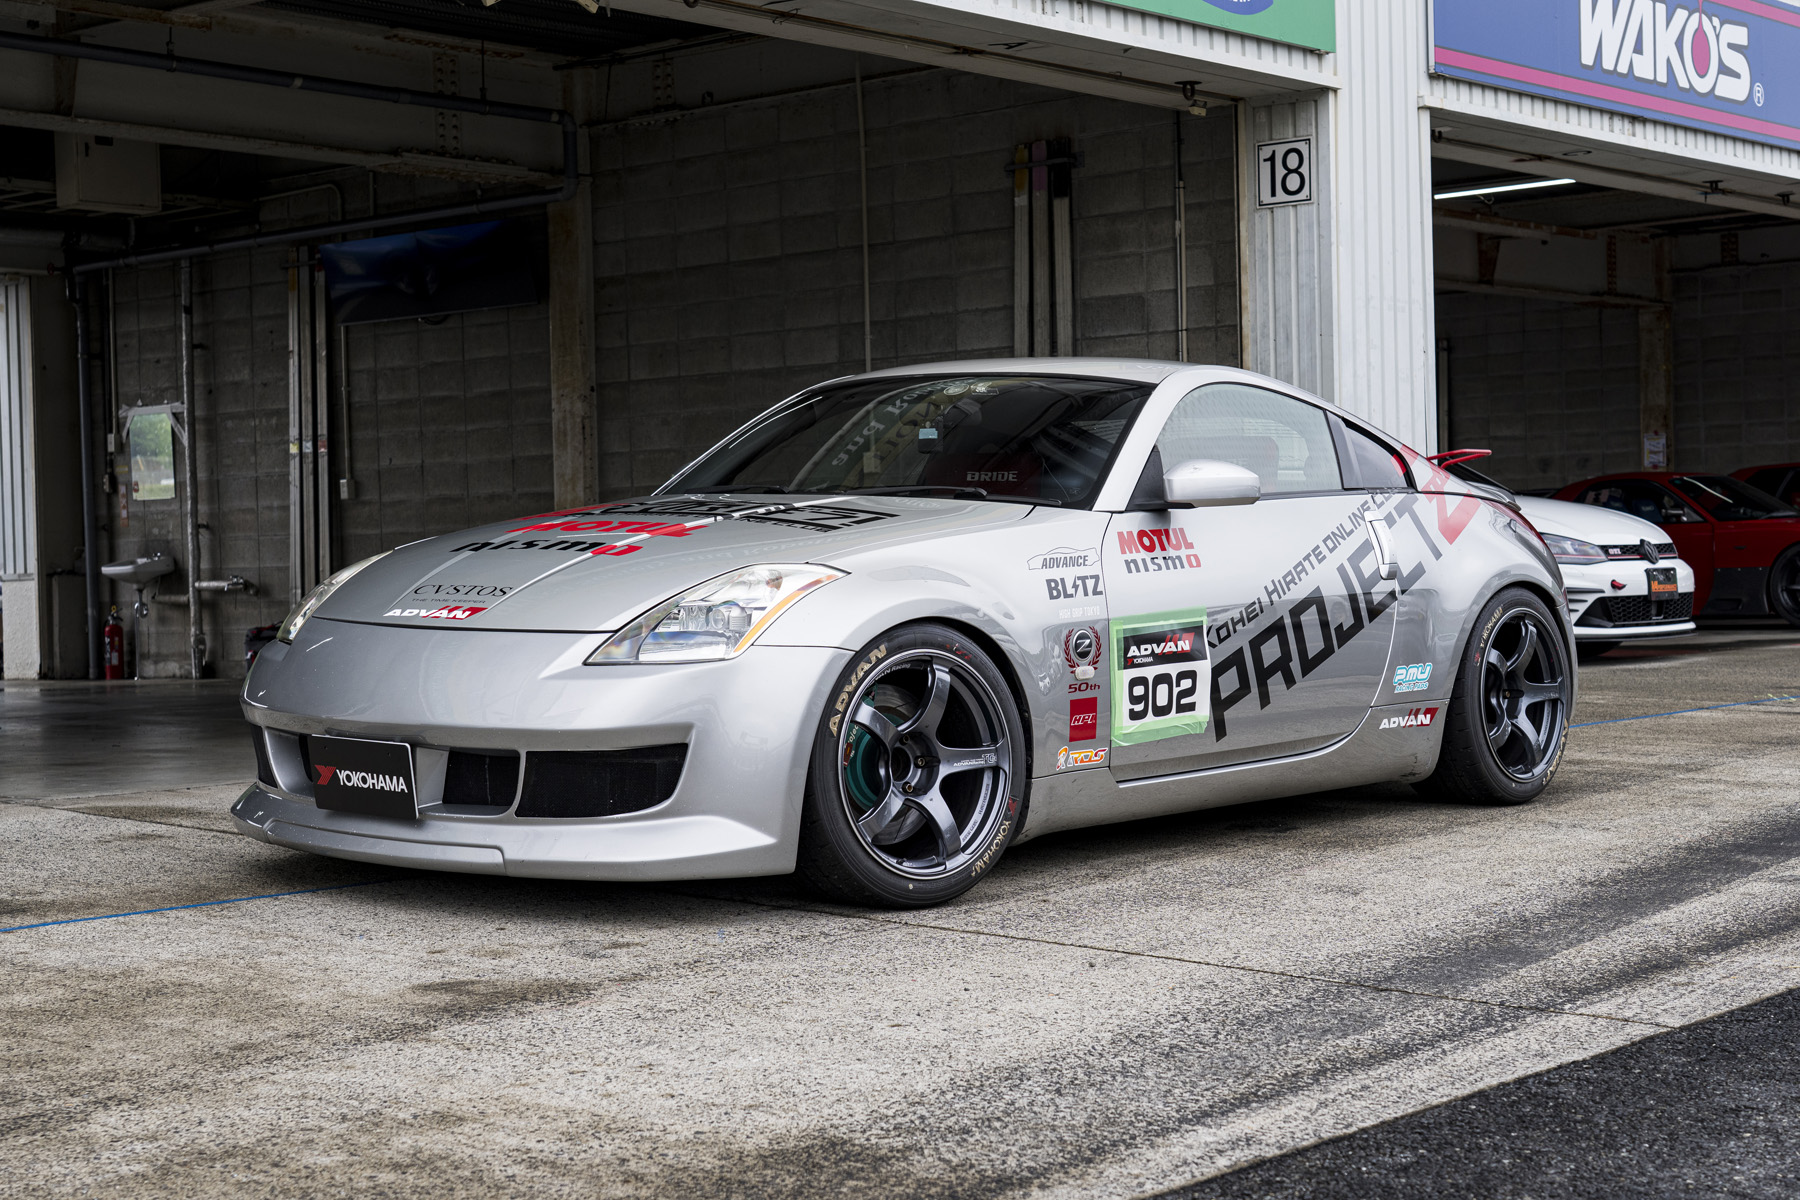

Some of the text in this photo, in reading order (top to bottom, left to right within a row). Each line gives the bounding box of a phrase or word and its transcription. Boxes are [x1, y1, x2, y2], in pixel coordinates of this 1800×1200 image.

[1261, 146, 1306, 199] 18
[966, 471, 1018, 482] BRIDE
[504, 520, 710, 538] MOTUL
[450, 539, 643, 556] nismo
[1117, 528, 1194, 554] MOTUL
[1041, 555, 1089, 570] ADVANCE
[1124, 553, 1201, 574] nismo
[1263, 545, 1327, 606] HIRATE
[413, 584, 514, 598] CVSTOS
[1046, 574, 1103, 600] BLITZ
[383, 608, 472, 620] ADVAN
[1127, 640, 1190, 657] ADVAN
[1133, 656, 1154, 665] YOKOHAMA
[829, 644, 888, 738] ADVAN
[1067, 682, 1101, 694] 50th
[1128, 669, 1198, 721] 902
[1395, 682, 1429, 693] RACING PADS
[1379, 713, 1431, 730] ADVAN
[336, 769, 408, 795] YOKOHAMA
